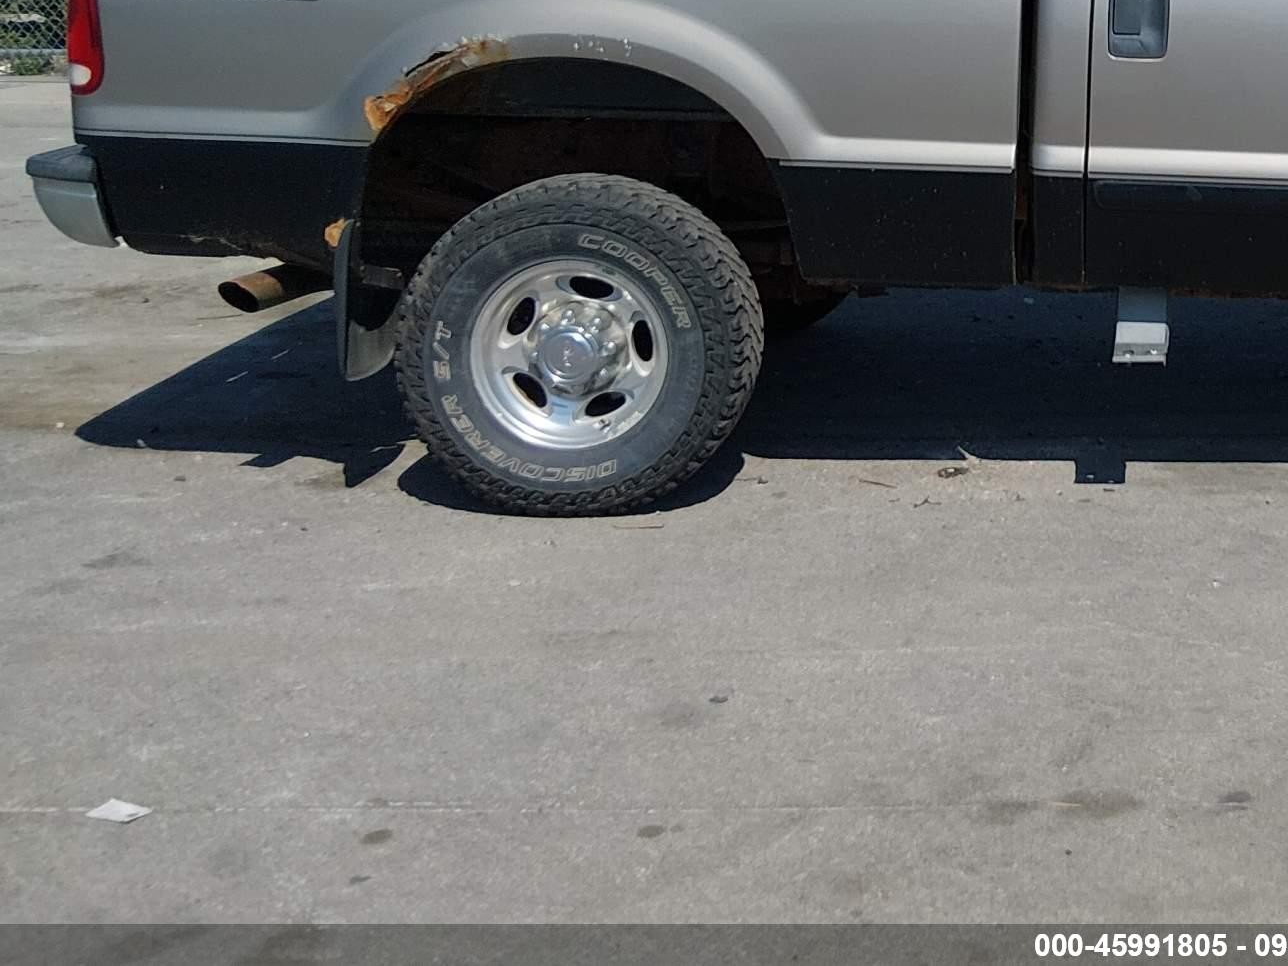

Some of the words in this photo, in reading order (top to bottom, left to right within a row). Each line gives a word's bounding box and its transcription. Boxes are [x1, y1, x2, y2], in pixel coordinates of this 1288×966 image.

[578, 233, 692, 329] COOPER
[432, 320, 452, 384] S/T
[441, 393, 617, 483] DISCOVERER
